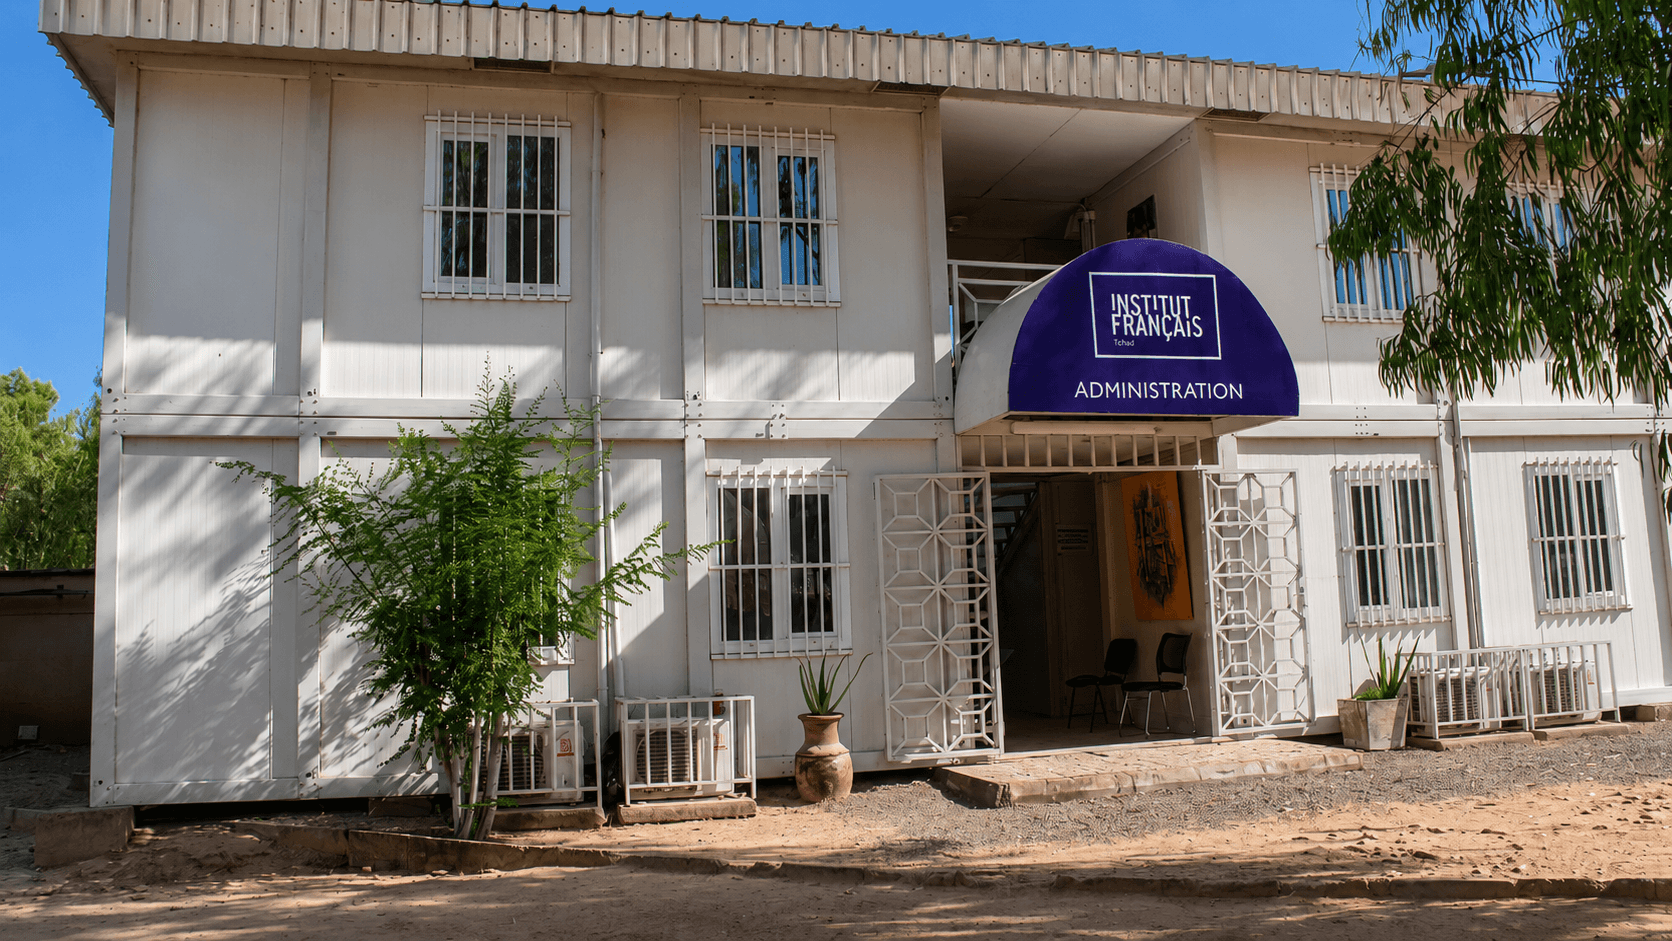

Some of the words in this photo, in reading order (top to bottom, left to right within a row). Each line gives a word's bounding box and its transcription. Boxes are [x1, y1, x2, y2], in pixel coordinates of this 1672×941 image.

[1111, 293, 1191, 319] INSTITUT
[1113, 339, 1135, 347] Tchad
[1074, 381, 1243, 400] ADMINISTRATION
